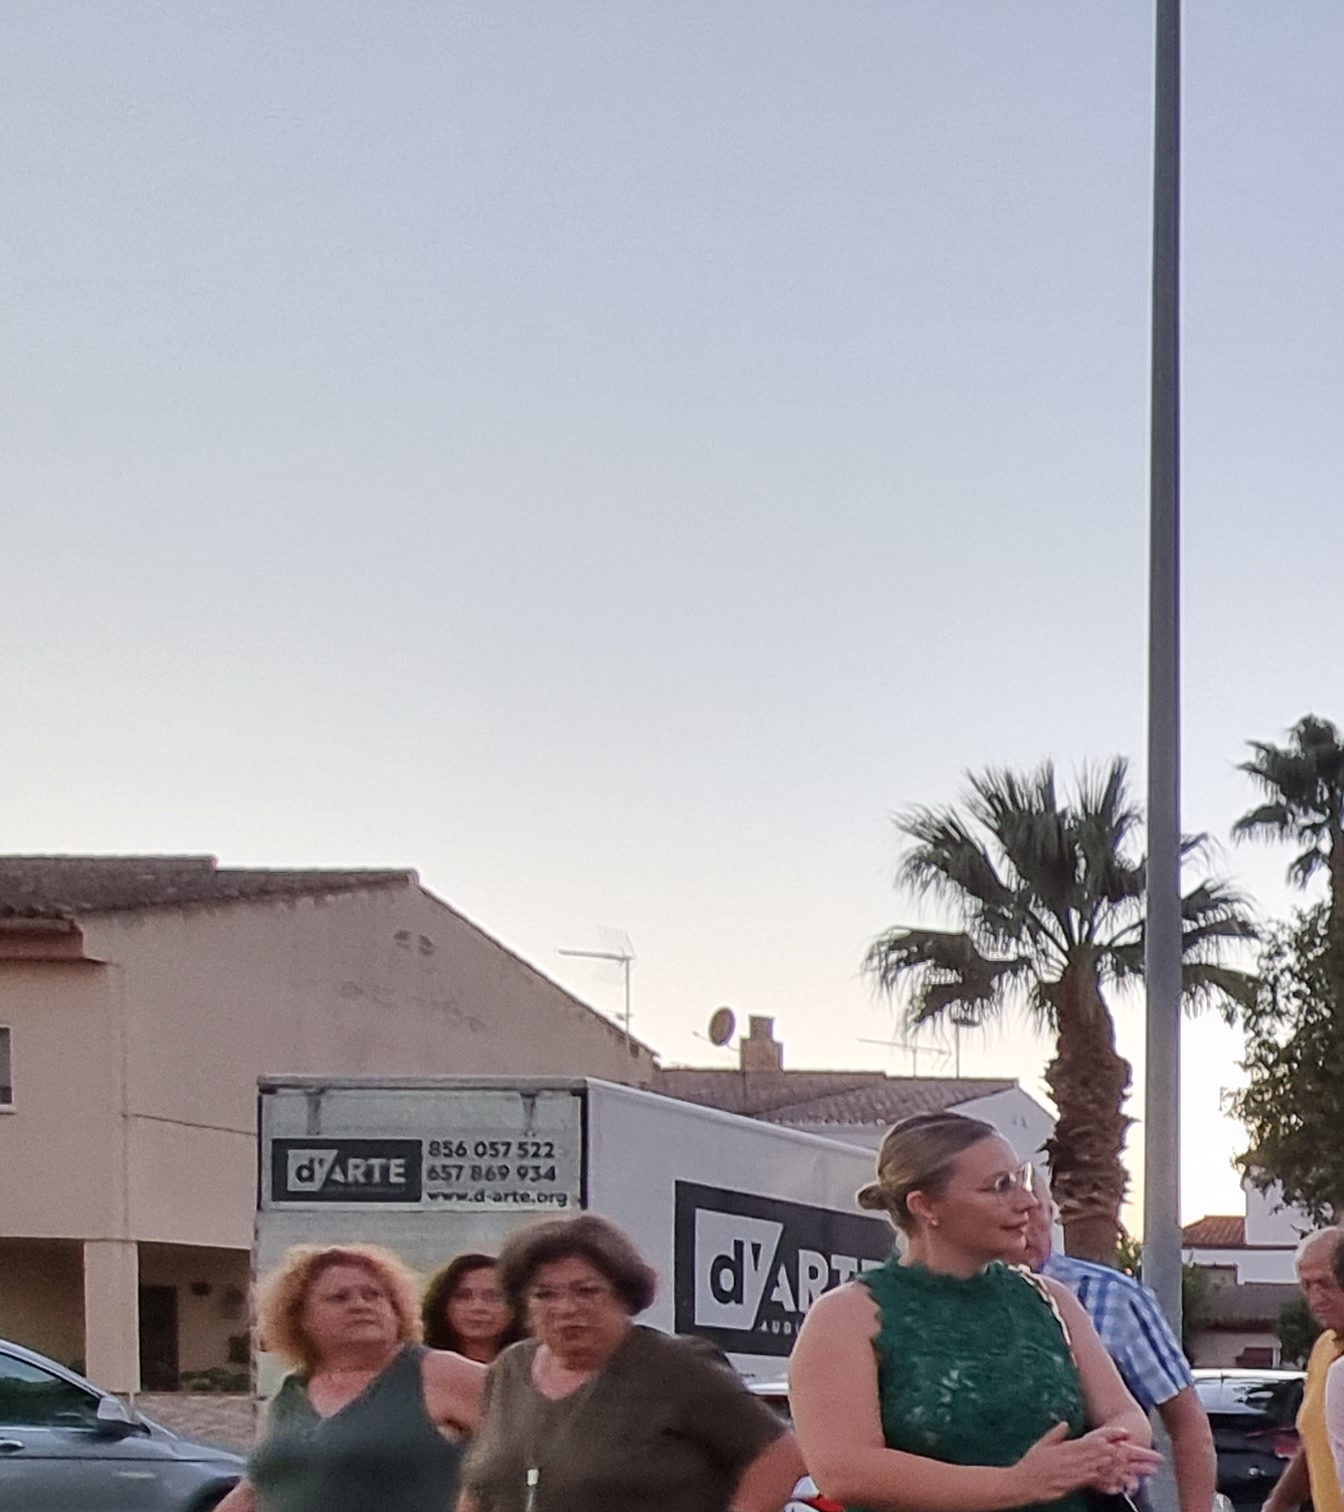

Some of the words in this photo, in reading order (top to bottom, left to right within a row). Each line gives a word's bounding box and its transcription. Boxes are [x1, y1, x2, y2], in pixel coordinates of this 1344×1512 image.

[428, 1140, 467, 1158] 856
[474, 1140, 512, 1158] 057
[518, 1141, 555, 1159] 522
[427, 1163, 464, 1181] 657
[470, 1164, 510, 1181] 869
[517, 1165, 556, 1182] 934
[427, 1188, 568, 1207] www.d-arte.org
[709, 1239, 886, 1313] d'ART
